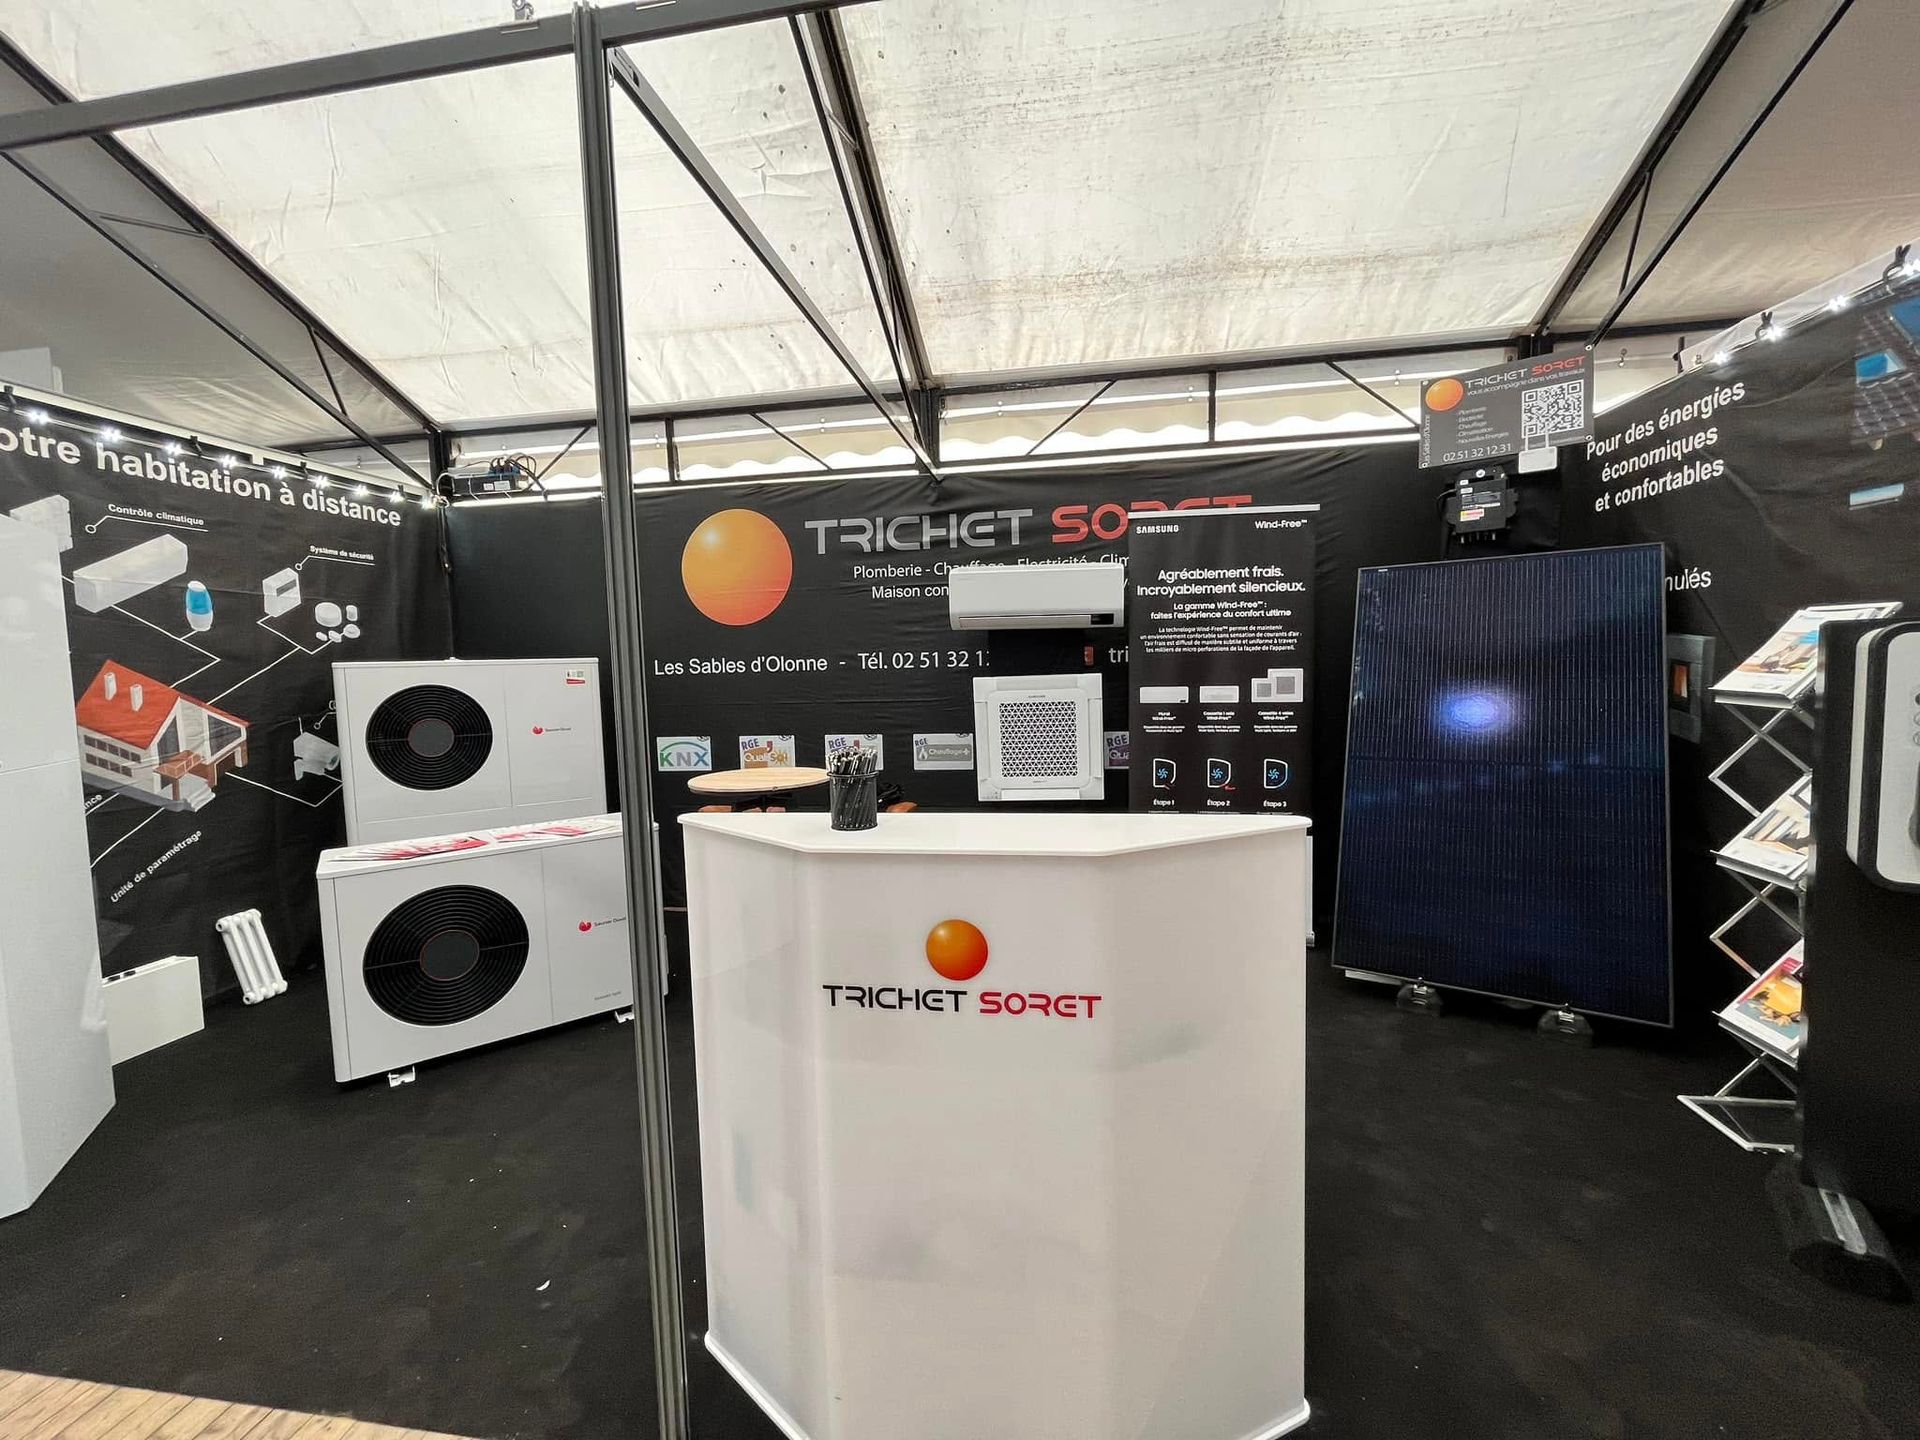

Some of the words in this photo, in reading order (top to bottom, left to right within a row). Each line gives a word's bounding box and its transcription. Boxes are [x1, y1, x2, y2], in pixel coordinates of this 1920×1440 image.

[1465, 368, 1528, 388] TRICHET
[1531, 356, 1586, 376] SORET
[1586, 434, 1621, 461] Pour
[1625, 421, 1654, 445] des
[1658, 380, 1746, 429] énergies
[1443, 452, 1456, 462] 02
[1457, 450, 1468, 460] 51
[1471, 447, 1484, 458] 32
[1487, 445, 1499, 455] 12
[1500, 443, 1511, 453] 31
[1601, 425, 1719, 482] économiques
[0, 426, 80, 465] otre
[96, 442, 271, 502] habitation
[279, 483, 296, 506] à
[302, 493, 402, 527] distance
[1595, 491, 1610, 513] et
[1614, 457, 1725, 507] confortables
[108, 503, 153, 519] Contrôle
[155, 511, 205, 526] climatique
[804, 508, 1033, 555] TRICHET
[1136, 524, 1179, 534] SAMSUNG
[1100, 553, 1129, 567] Clim
[853, 563, 922, 579] Plomberie
[1158, 566, 1250, 583] Agréablement
[1252, 565, 1285, 578] frais.
[1665, 567, 1712, 591] nulés
[871, 585, 920, 599] Maison
[924, 586, 949, 597] con
[1137, 582, 1237, 598] Incroyablement
[1238, 580, 1306, 593] silencieux.
[1150, 611, 1173, 619] faites
[1222, 610, 1234, 618] du
[1235, 609, 1265, 617] confort
[1265, 608, 1292, 617] ultime
[1184, 603, 1215, 612] gamme
[654, 659, 684, 676] Les
[689, 655, 746, 674] Sables
[858, 652, 888, 670] Tél.
[892, 652, 914, 669] 02
[919, 652, 939, 668] 51
[947, 651, 969, 668] 32
[1108, 646, 1129, 663] tri
[741, 738, 760, 750] RGE
[828, 737, 847, 749] RGE
[914, 738, 928, 747] RGE
[1106, 734, 1128, 747] RGE
[660, 752, 709, 767] KNX
[110, 881, 134, 904] Unité
[133, 870, 148, 885] de
[146, 830, 203, 873] paramétrage
[822, 985, 968, 1012] TRICHET
[979, 991, 1102, 1019] SORET
